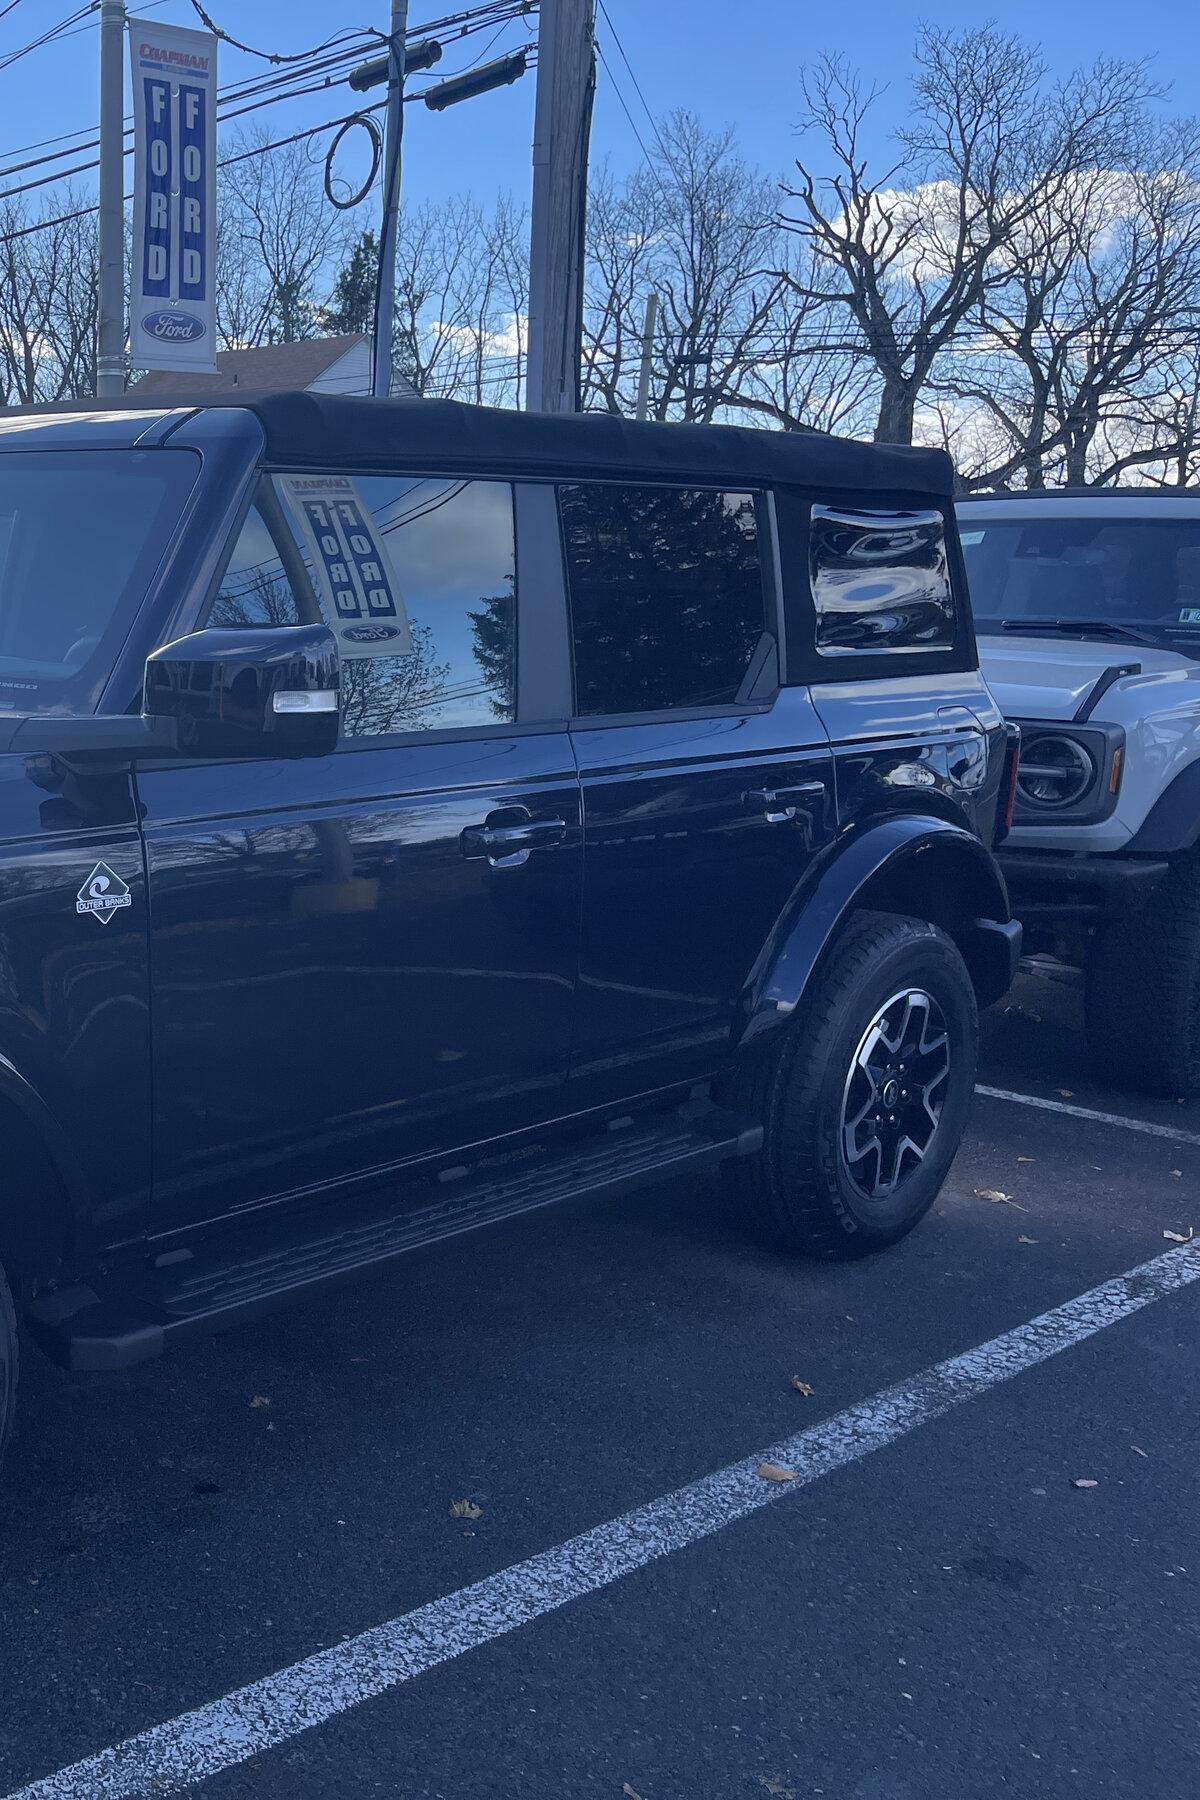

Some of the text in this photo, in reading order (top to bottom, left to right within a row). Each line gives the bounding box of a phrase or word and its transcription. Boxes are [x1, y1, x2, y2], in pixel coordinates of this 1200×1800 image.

[140, 44, 209, 70] CHAPMAN
[148, 85, 168, 282] FORD
[184, 92, 201, 285] FORD
[154, 315, 195, 340] Ford
[79, 896, 130, 911] OUTER BANKS
